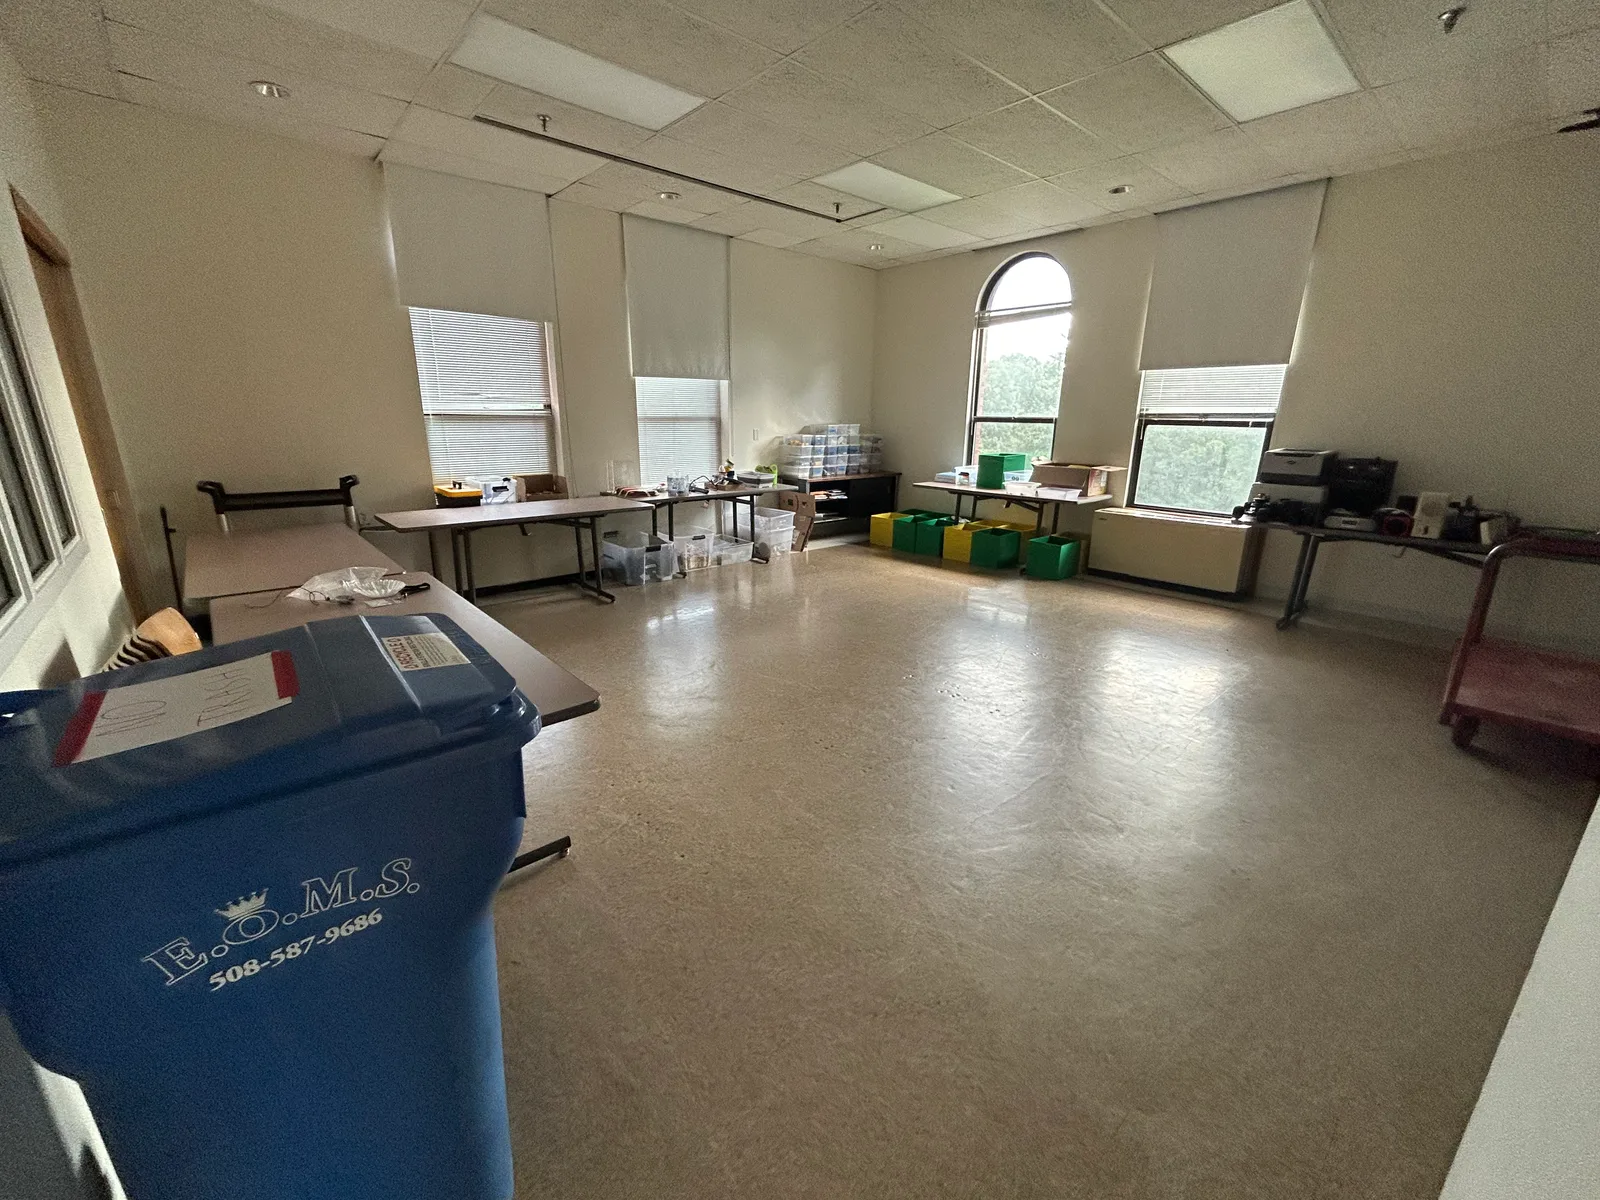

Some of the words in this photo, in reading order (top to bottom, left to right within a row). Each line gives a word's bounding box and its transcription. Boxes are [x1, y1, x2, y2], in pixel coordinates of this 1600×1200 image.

[95, 701, 167, 736] NO
[197, 668, 252, 726] TRASH
[140, 857, 420, 985] E.O.M.S.
[209, 908, 383, 991] 508-587-9686
